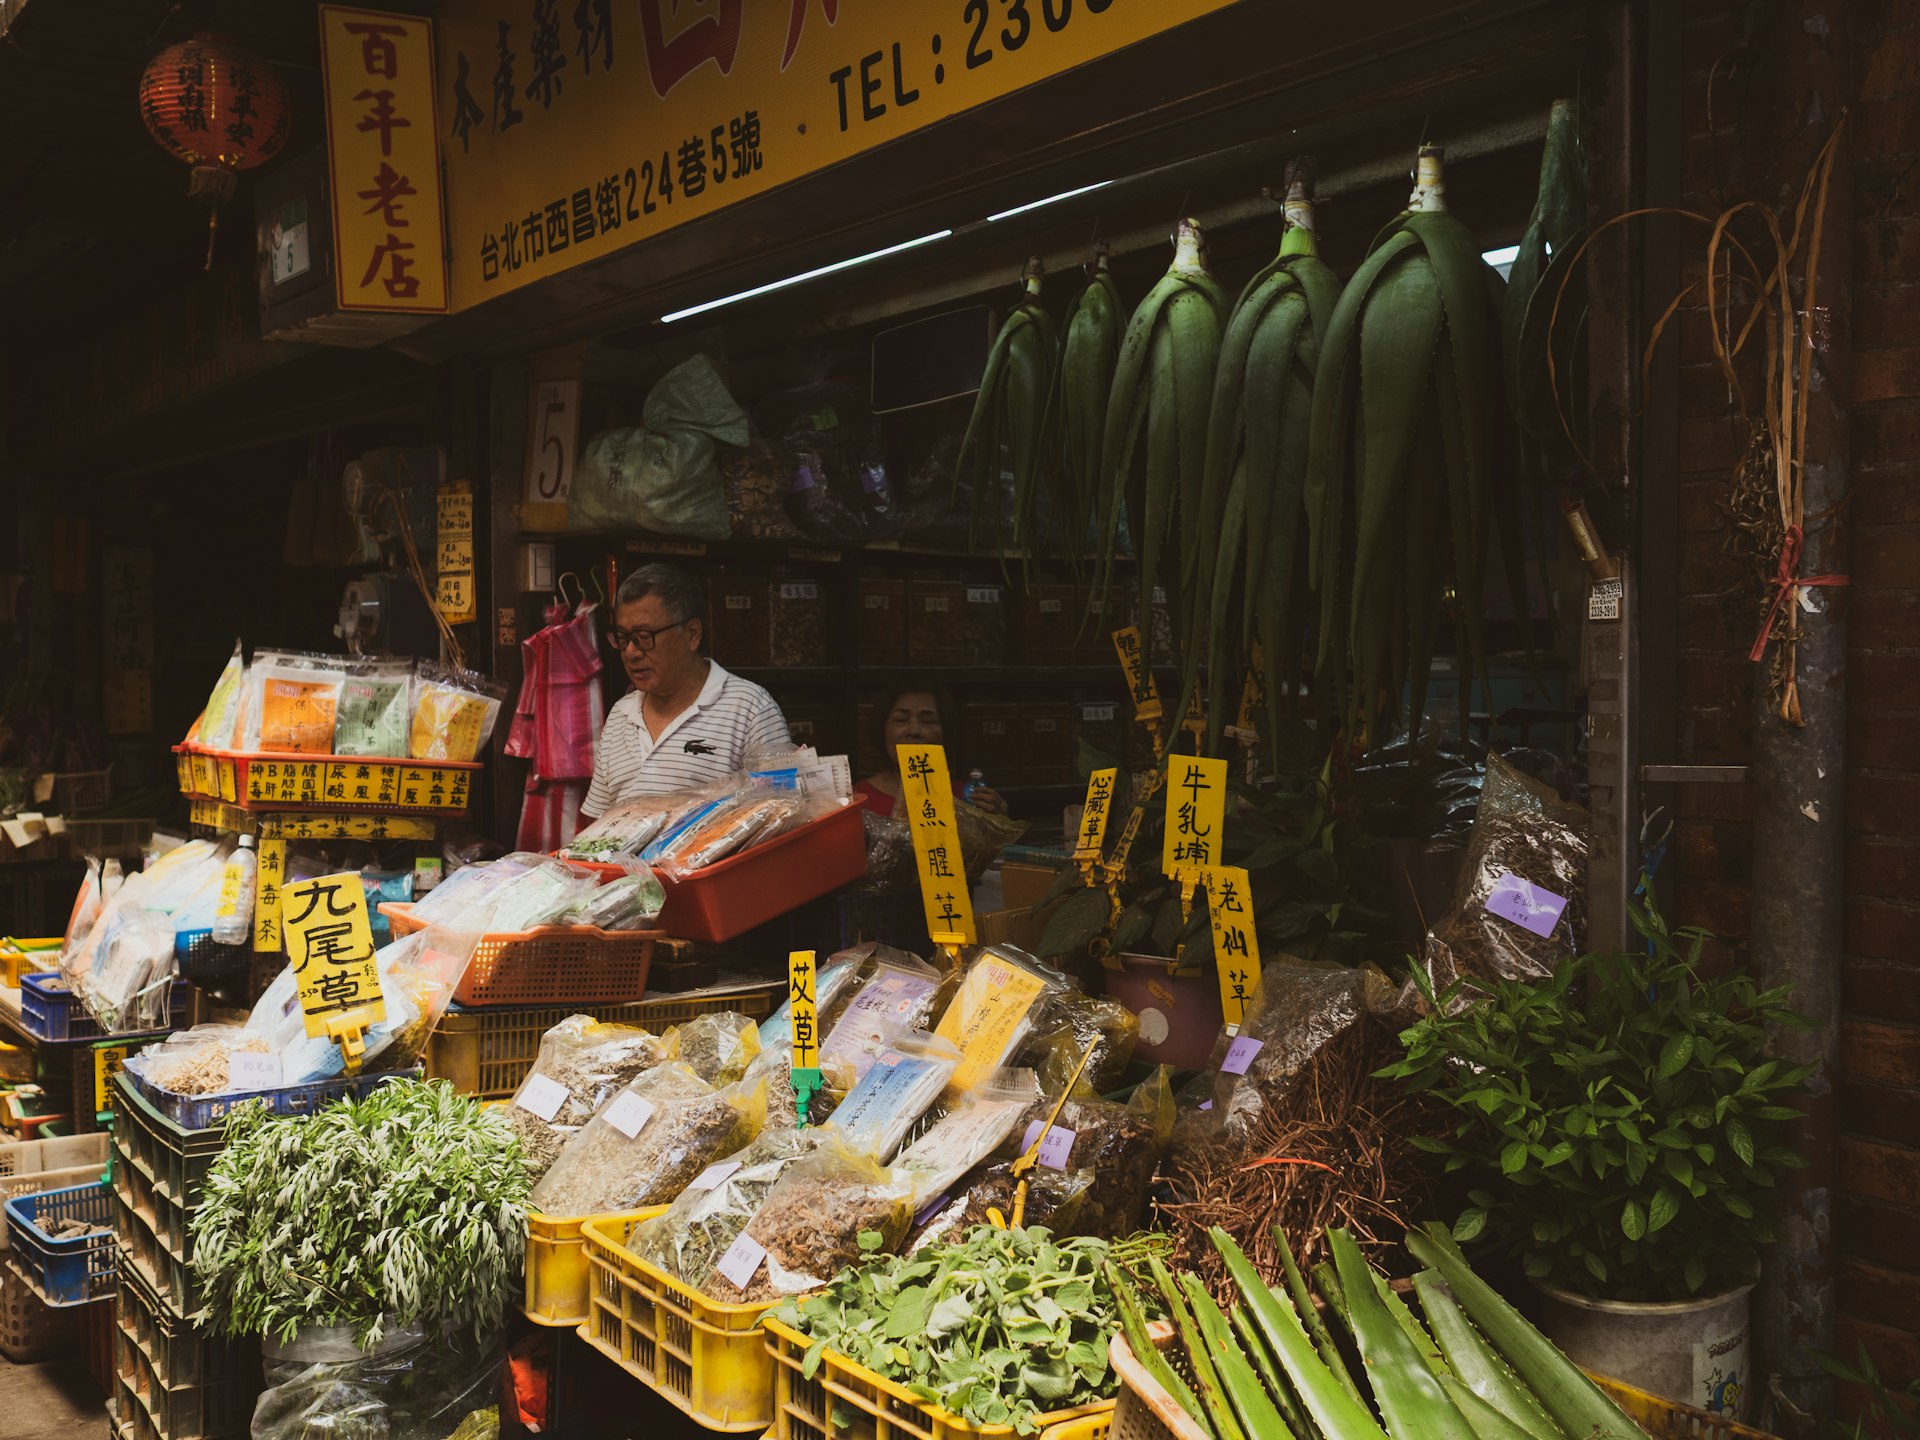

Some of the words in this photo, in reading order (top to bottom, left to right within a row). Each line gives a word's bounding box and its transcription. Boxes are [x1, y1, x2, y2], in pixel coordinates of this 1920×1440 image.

[964, 0, 1113, 69] 230
[344, 21, 421, 299] 百年老店
[480, 110, 763, 281] 台北市西昌街224巷5號
[538, 402, 566, 500] 5
[441, 592, 465, 606] 休息
[250, 763, 264, 799] 排毒
[265, 764, 277, 798] B肝
[281, 763, 296, 801] 脂肪肝
[300, 763, 320, 801] 膽固醇
[327, 764, 347, 800] 尿酸
[353, 765, 370, 800] 痛風
[403, 770, 425, 804] 血壓
[1173, 764, 1212, 865] 牛乳埔
[907, 752, 963, 932] 鮮魚腥草
[258, 850, 281, 943] 清毒茶
[288, 880, 384, 1016] 九尾草
[1218, 877, 1251, 1019] 老仙草
[791, 961, 815, 1068] 艾草
